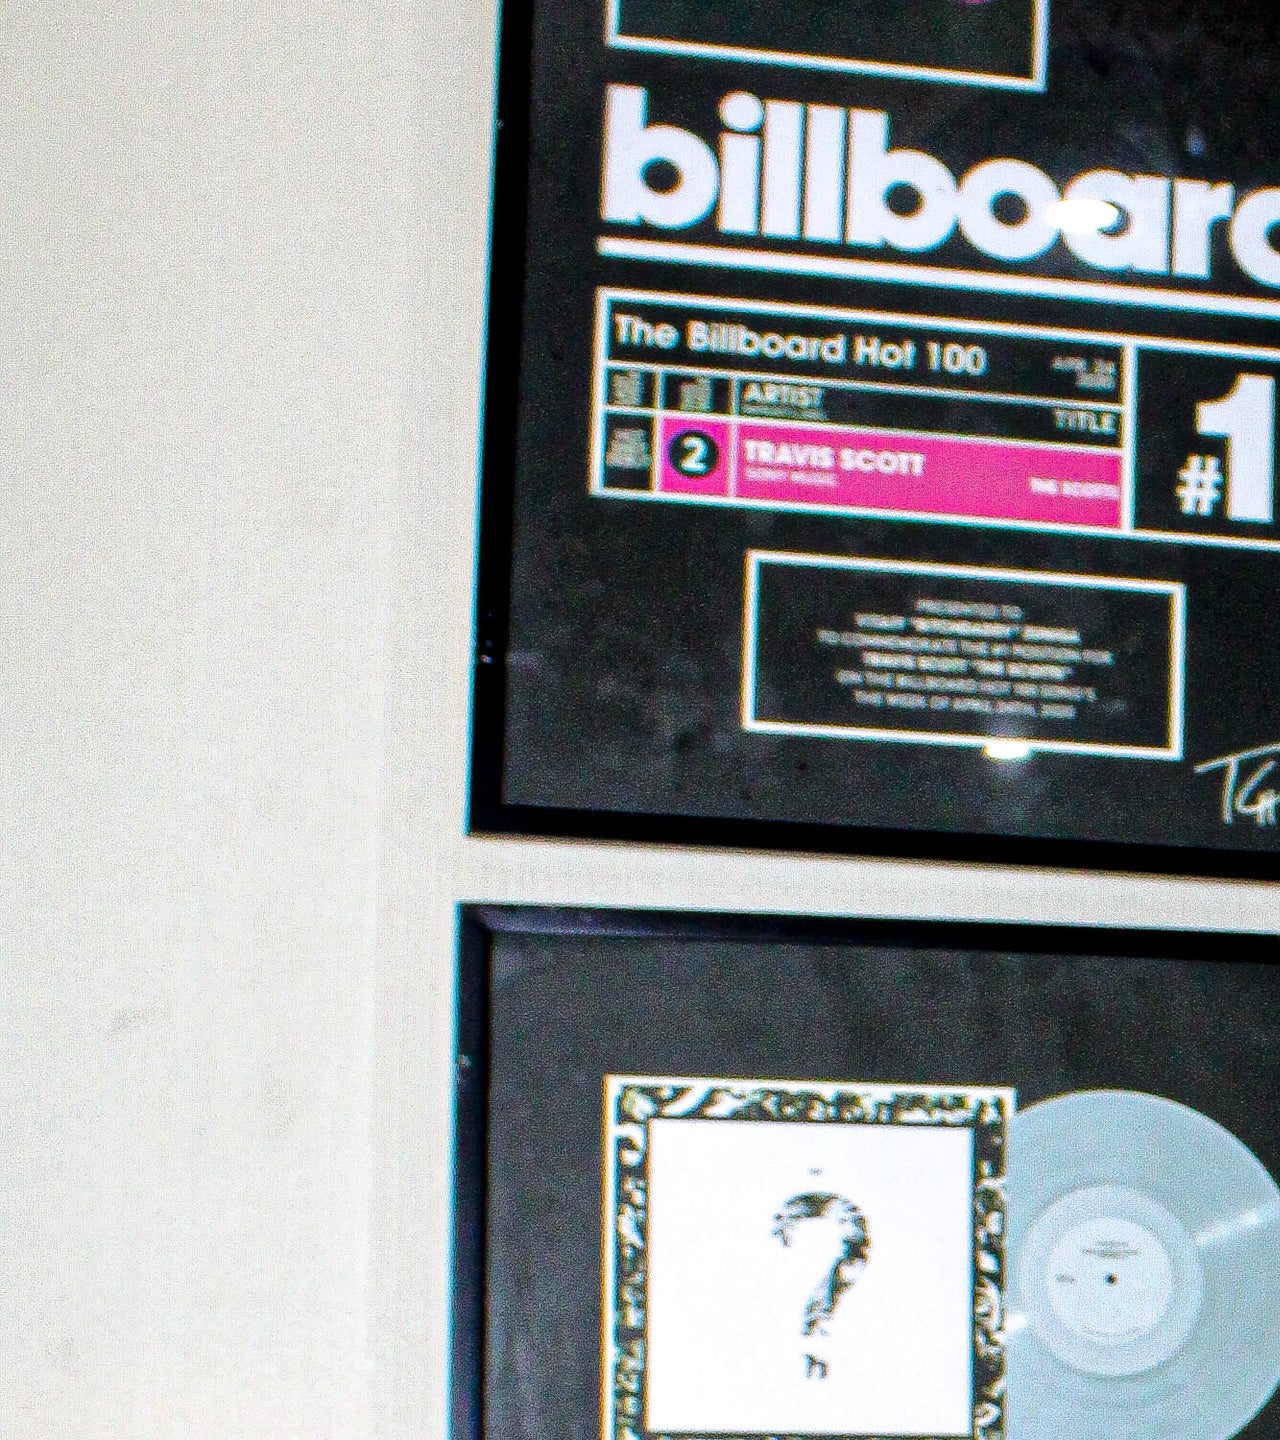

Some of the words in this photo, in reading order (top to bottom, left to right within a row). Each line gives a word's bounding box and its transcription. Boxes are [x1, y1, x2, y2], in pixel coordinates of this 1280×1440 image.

[614, 313, 679, 349] The
[687, 319, 848, 366] Billboard
[853, 336, 915, 371] Hot
[928, 342, 986, 376] 100
[742, 382, 825, 407] ARTIST
[1053, 408, 1117, 434] TITLE
[679, 438, 707, 471] 2
[744, 439, 836, 469] TRAVIS
[839, 447, 926, 477] SCOTT
[1176, 372, 1276, 524] #1
